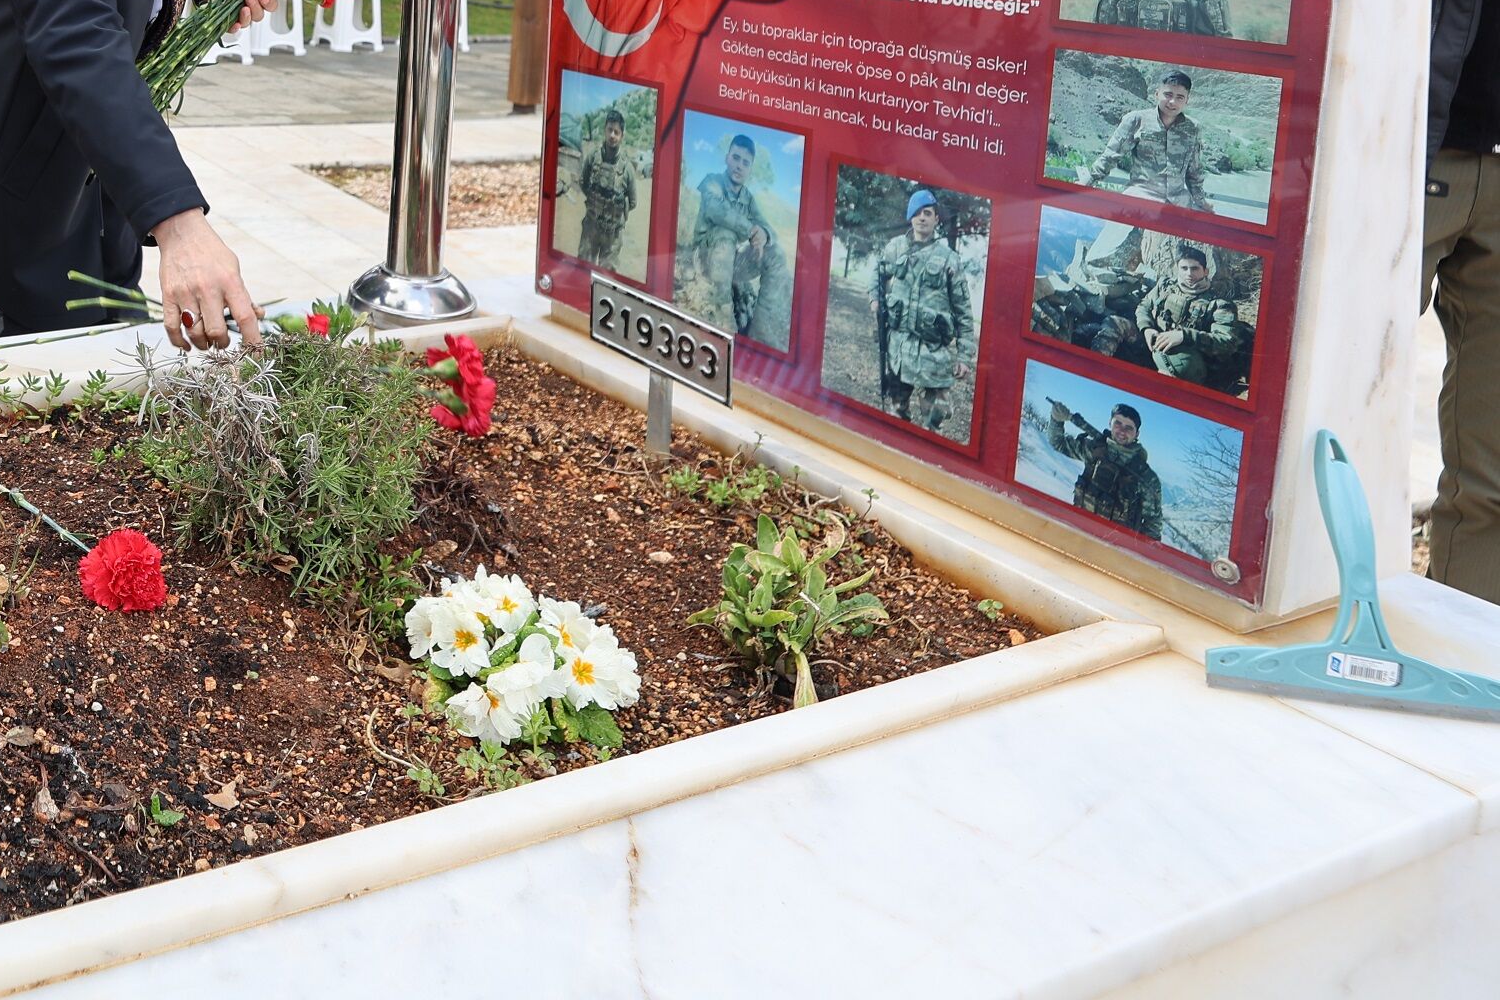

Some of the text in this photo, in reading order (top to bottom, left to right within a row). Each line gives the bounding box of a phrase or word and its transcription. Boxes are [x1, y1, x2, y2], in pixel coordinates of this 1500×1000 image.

[721, 39, 1029, 104] Gökten ecdâd inerek öpse o pâk alnı değer.
[743, 19, 758, 34] bu
[762, 22, 818, 44] topraklar
[821, 30, 844, 48] için
[849, 35, 904, 58] toprağa
[908, 44, 972, 70] düşmüş
[976, 56, 1027, 75] asker!
[720, 62, 738, 77] Ne
[740, 65, 801, 89] büyüksün
[804, 77, 815, 91] ki
[819, 79, 855, 99] kanın
[859, 87, 929, 113] kurtarıyor
[763, 95, 820, 117] arslanları
[824, 108, 868, 128] ancak,
[872, 114, 891, 132] bu
[895, 119, 938, 141] kadar
[942, 132, 979, 150] şanlı
[983, 136, 1006, 156] idi.
[598, 297, 719, 380] 219383
